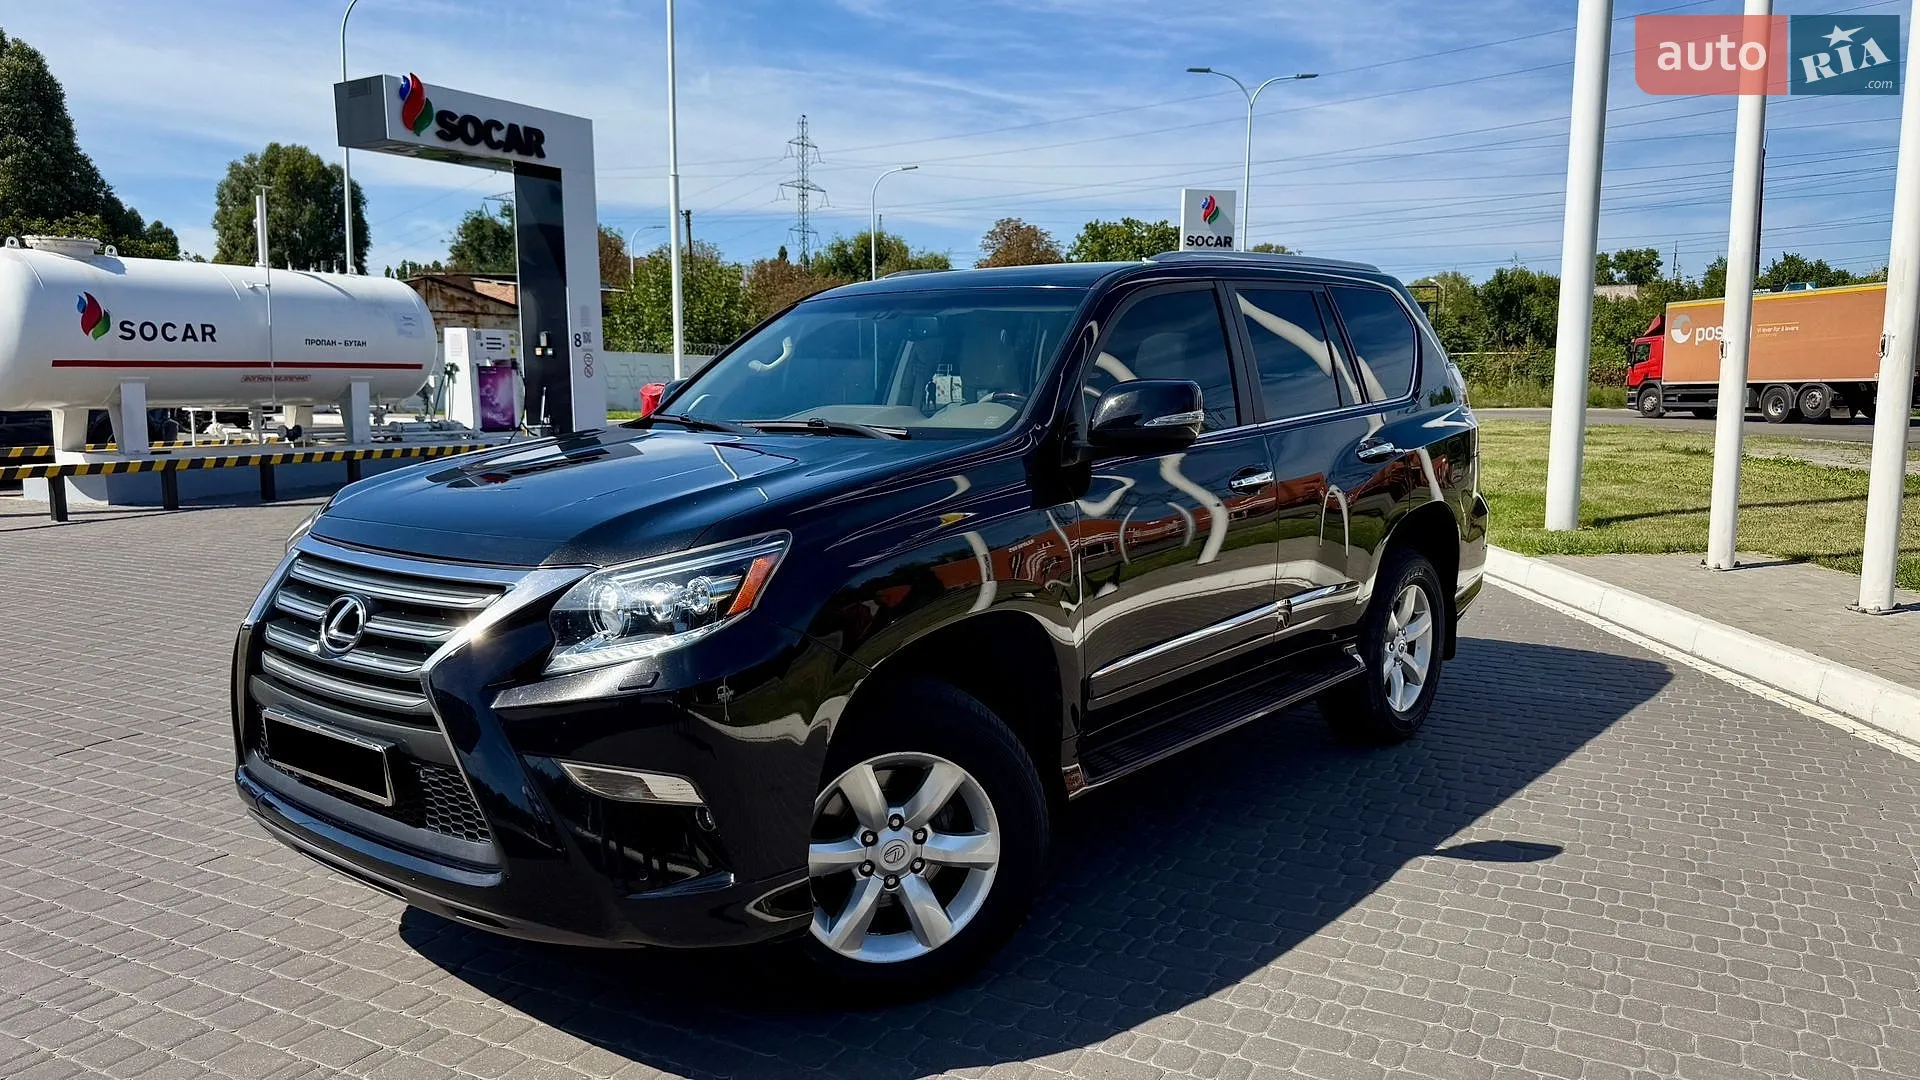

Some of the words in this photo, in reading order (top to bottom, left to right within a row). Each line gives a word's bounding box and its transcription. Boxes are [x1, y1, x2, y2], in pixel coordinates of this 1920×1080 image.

[435, 109, 546, 158] SOCAR
[1186, 235, 1233, 248] SOCAR
[118, 320, 217, 342] SOCAR
[305, 338, 337, 347] ПРОПАН
[344, 340, 367, 348] БУТАН
[574, 333, 582, 348] 8
